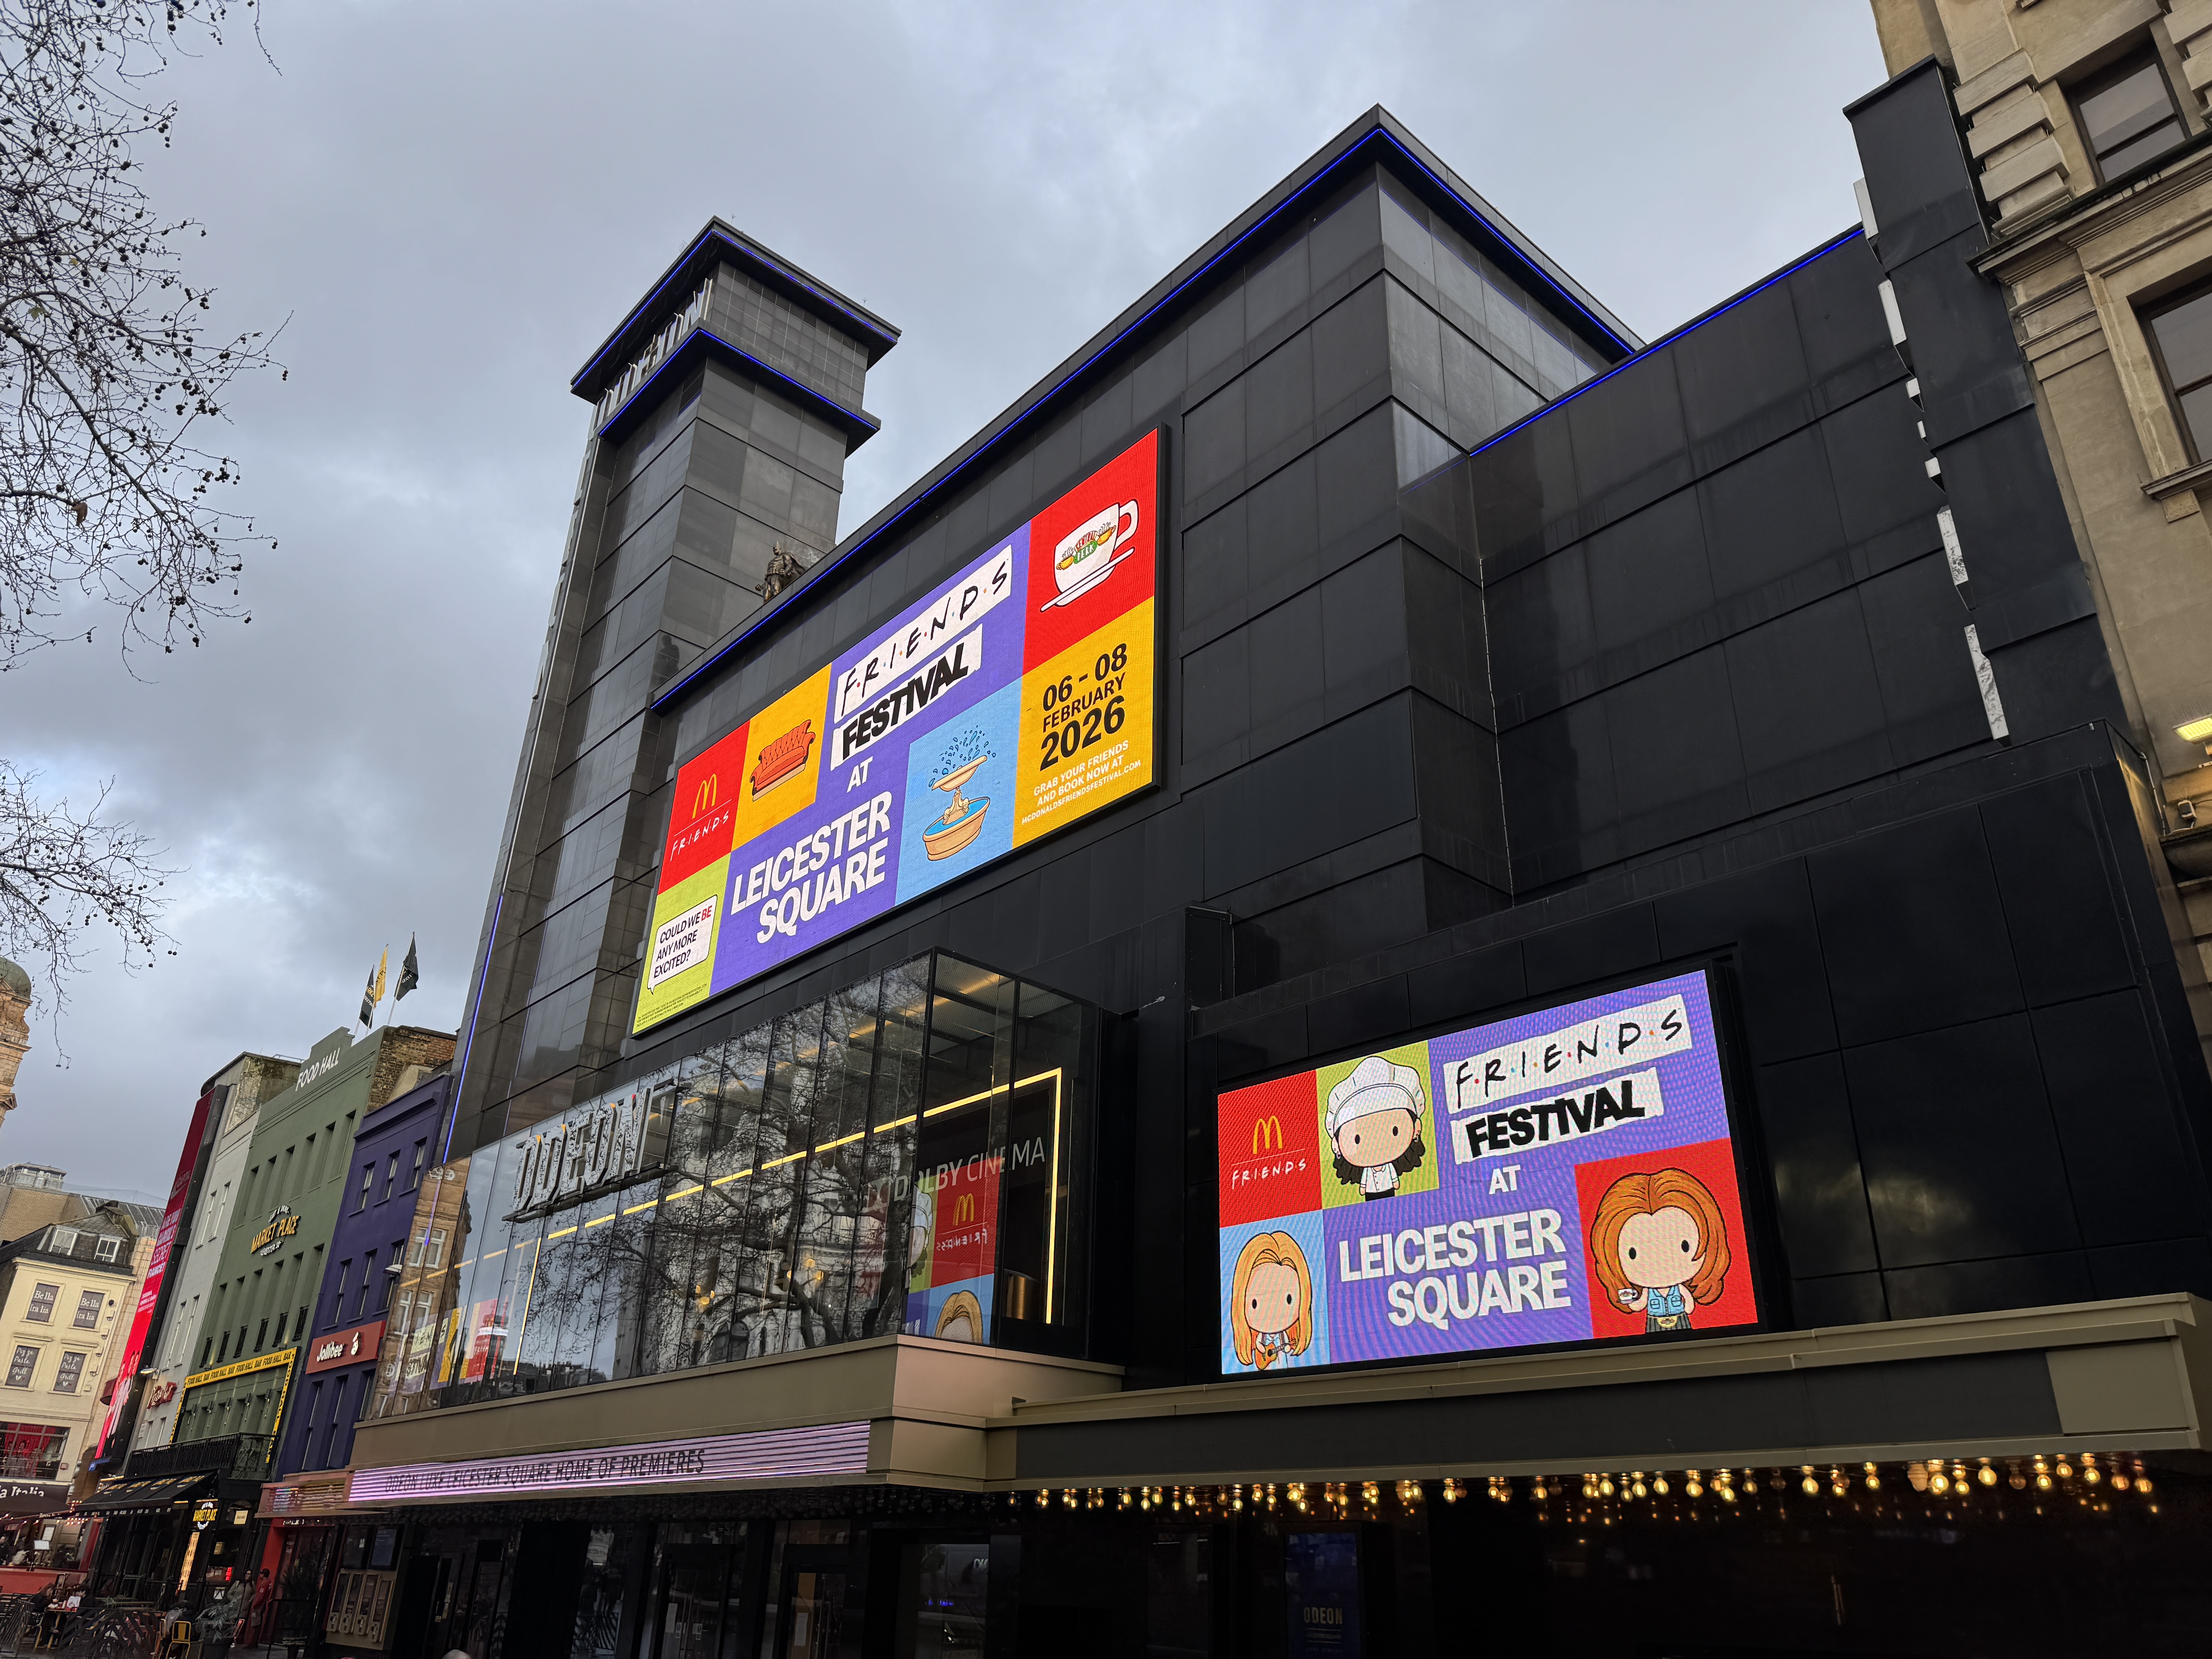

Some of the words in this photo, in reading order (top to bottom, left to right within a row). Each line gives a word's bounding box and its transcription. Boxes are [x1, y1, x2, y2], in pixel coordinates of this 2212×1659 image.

[1043, 675, 1072, 711] 06
[1095, 643, 1127, 681] 08
[843, 642, 969, 761] FESTIVAL
[1043, 672, 1126, 733] FEBRUARY
[1040, 695, 1125, 771] 2026
[847, 756, 873, 793] AT
[1034, 776, 1058, 796] GRAB
[1060, 763, 1085, 783] YOUR
[1087, 740, 1128, 768] FRIENDS
[1037, 791, 1056, 807] AND
[1058, 775, 1084, 796] BOOK
[1086, 761, 1109, 781] NOW
[1111, 755, 1123, 769] AT
[1022, 759, 1141, 825] MCDONALDSFRIENDSFESTIVAL.COM
[731, 791, 892, 915] LEICESTER
[757, 837, 888, 944] SQUARE
[656, 942, 674, 962] ANY
[673, 929, 698, 953] MORE
[660, 920, 687, 944] COULD
[688, 912, 701, 929] WE
[701, 905, 713, 921] BE
[654, 949, 691, 979] EXCITED?
[295, 1062, 319, 1091] FOOD
[319, 1047, 340, 1076] HALL
[1466, 1080, 1645, 1158] FESTIVAL
[512, 1088, 653, 1212] ODEON
[967, 1137, 1046, 1182] CINEMA
[1489, 1165, 1521, 1195] AT
[251, 1222, 278, 1254] MARKET
[277, 1216, 299, 1237] PLACE
[1339, 1209, 1566, 1282] LEICESTER
[34, 1290, 54, 1301] Bella
[80, 1298, 99, 1307] Bella
[1388, 1261, 1571, 1330] SQUARE
[17, 1348, 34, 1356] Pizza
[64, 1354, 81, 1363] Pizza
[187, 1377, 195, 1386] FOOD
[210, 1370, 219, 1379] FOOD
[218, 1369, 227, 1377] HALL
[236, 1364, 245, 1373] FOOD
[244, 1361, 254, 1370] HALL
[254, 1359, 263, 1367] BAR
[263, 1357, 271, 1365] FOOD
[272, 1354, 282, 1364] HALL
[283, 1352, 292, 1360] BAR
[316, 1341, 343, 1362] Jollibee
[385, 1474, 417, 1492] ODEON
[447, 1466, 501, 1488] LEICESTER
[504, 1462, 552, 1489] SQUARE
[555, 1459, 594, 1481] HOME
[599, 1456, 617, 1479] OF
[620, 1449, 705, 1477] PREMIERES
[1304, 1607, 1343, 1625] ODEON
